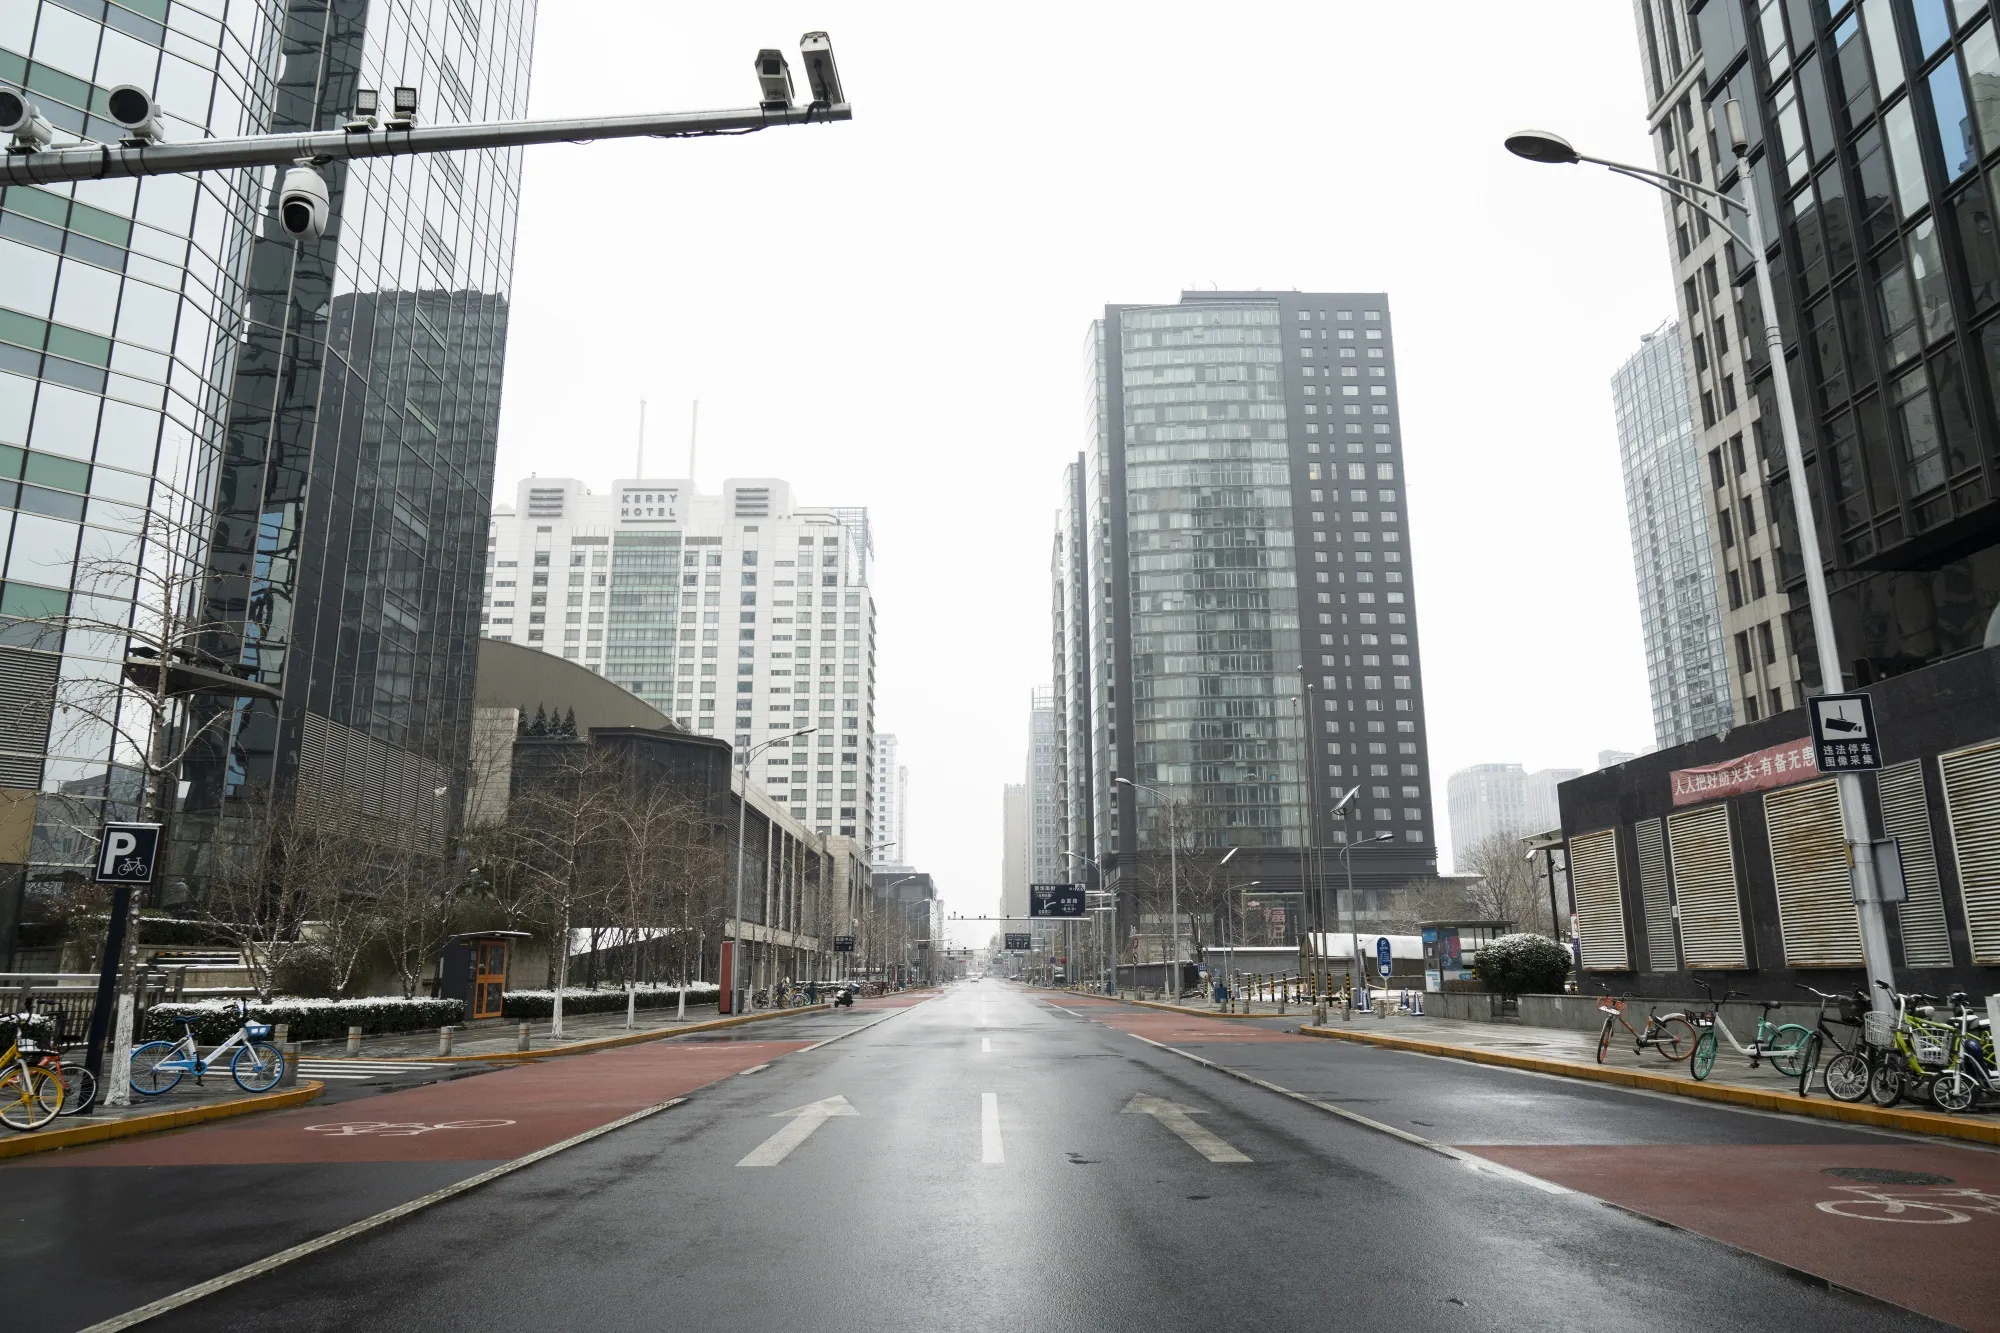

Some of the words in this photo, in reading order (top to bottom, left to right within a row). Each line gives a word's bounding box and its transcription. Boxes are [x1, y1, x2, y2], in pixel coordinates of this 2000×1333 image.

[621, 494, 678, 504] KERRY
[621, 507, 676, 517] HOTEL
[1823, 743, 1871, 756] 违法停车
[1825, 754, 1873, 767] 图像采集
[103, 831, 136, 875] P
